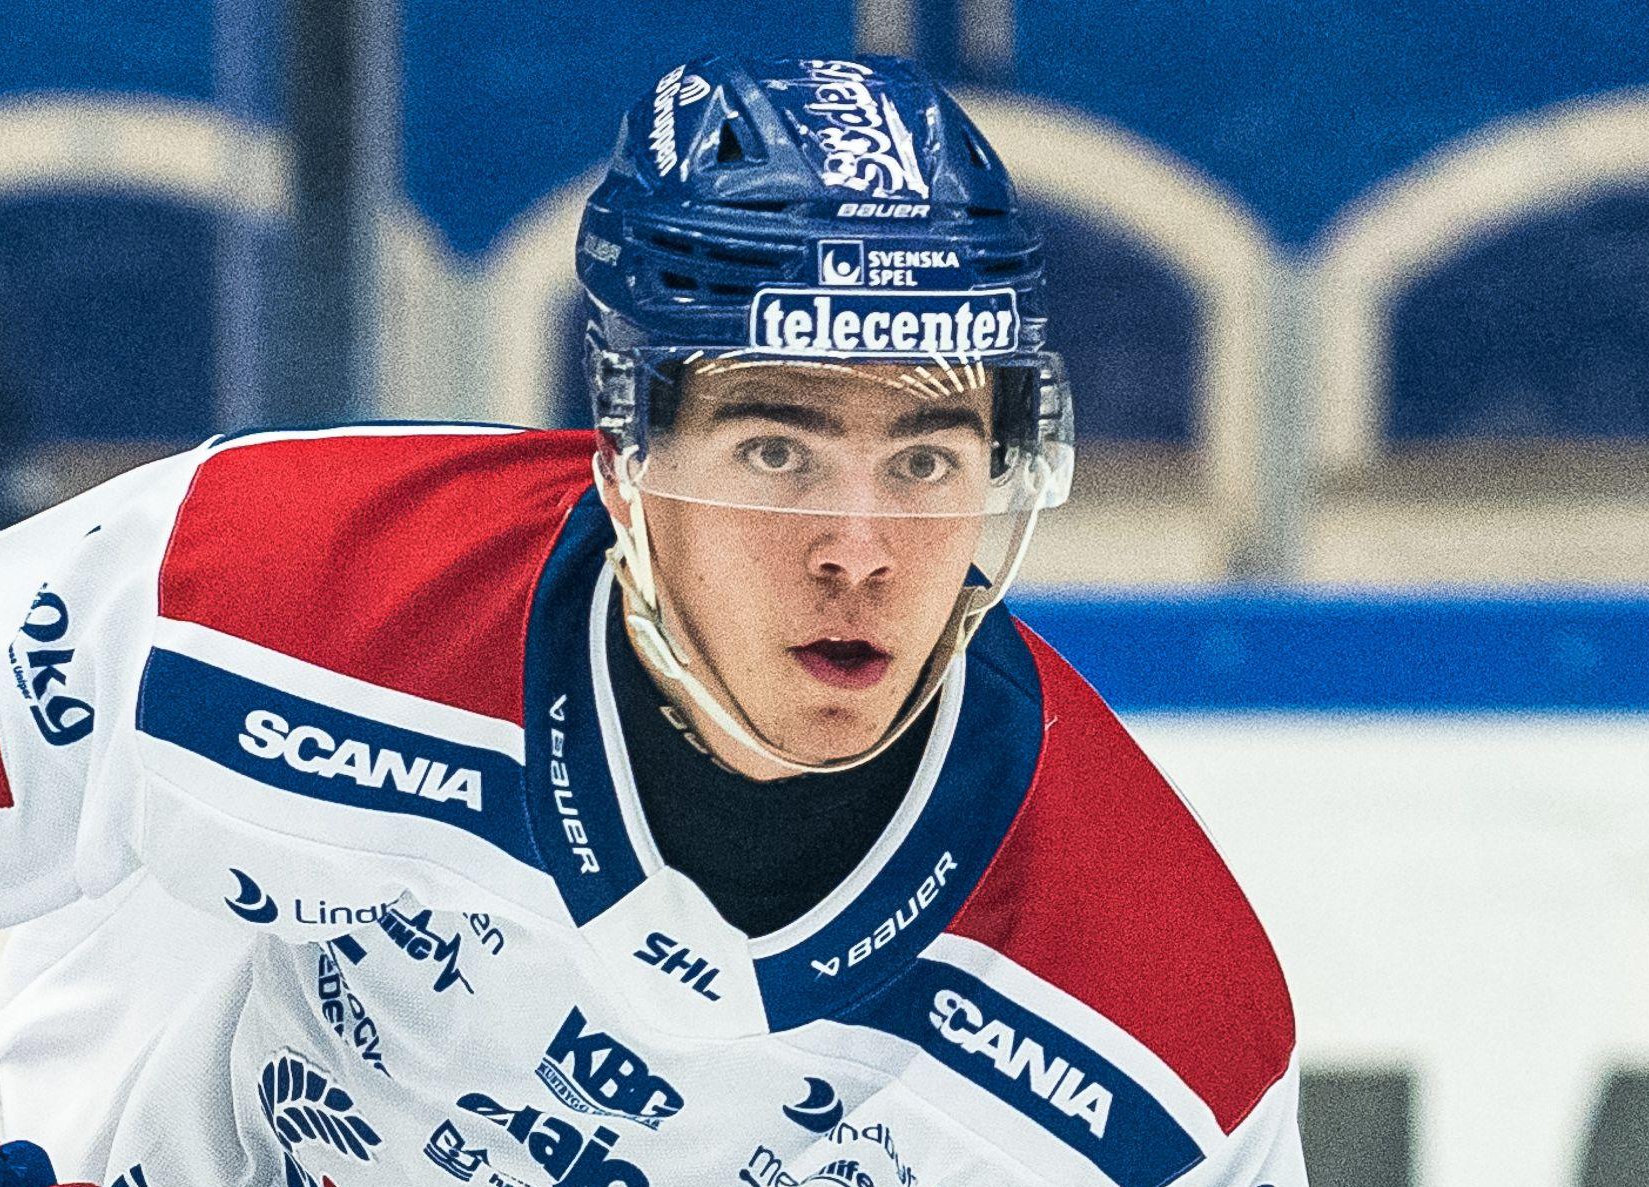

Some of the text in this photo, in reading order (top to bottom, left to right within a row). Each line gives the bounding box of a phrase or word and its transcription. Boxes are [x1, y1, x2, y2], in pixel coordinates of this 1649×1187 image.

[867, 250, 960, 269] SVENSKA
[867, 269, 918, 287] SPEL
[763, 295, 1013, 352] telecenter
[239, 709, 482, 812] SCANIA
[633, 931, 723, 1003] SHL
[546, 1004, 685, 1118] KBG
[930, 988, 1113, 1139] SCANIA
